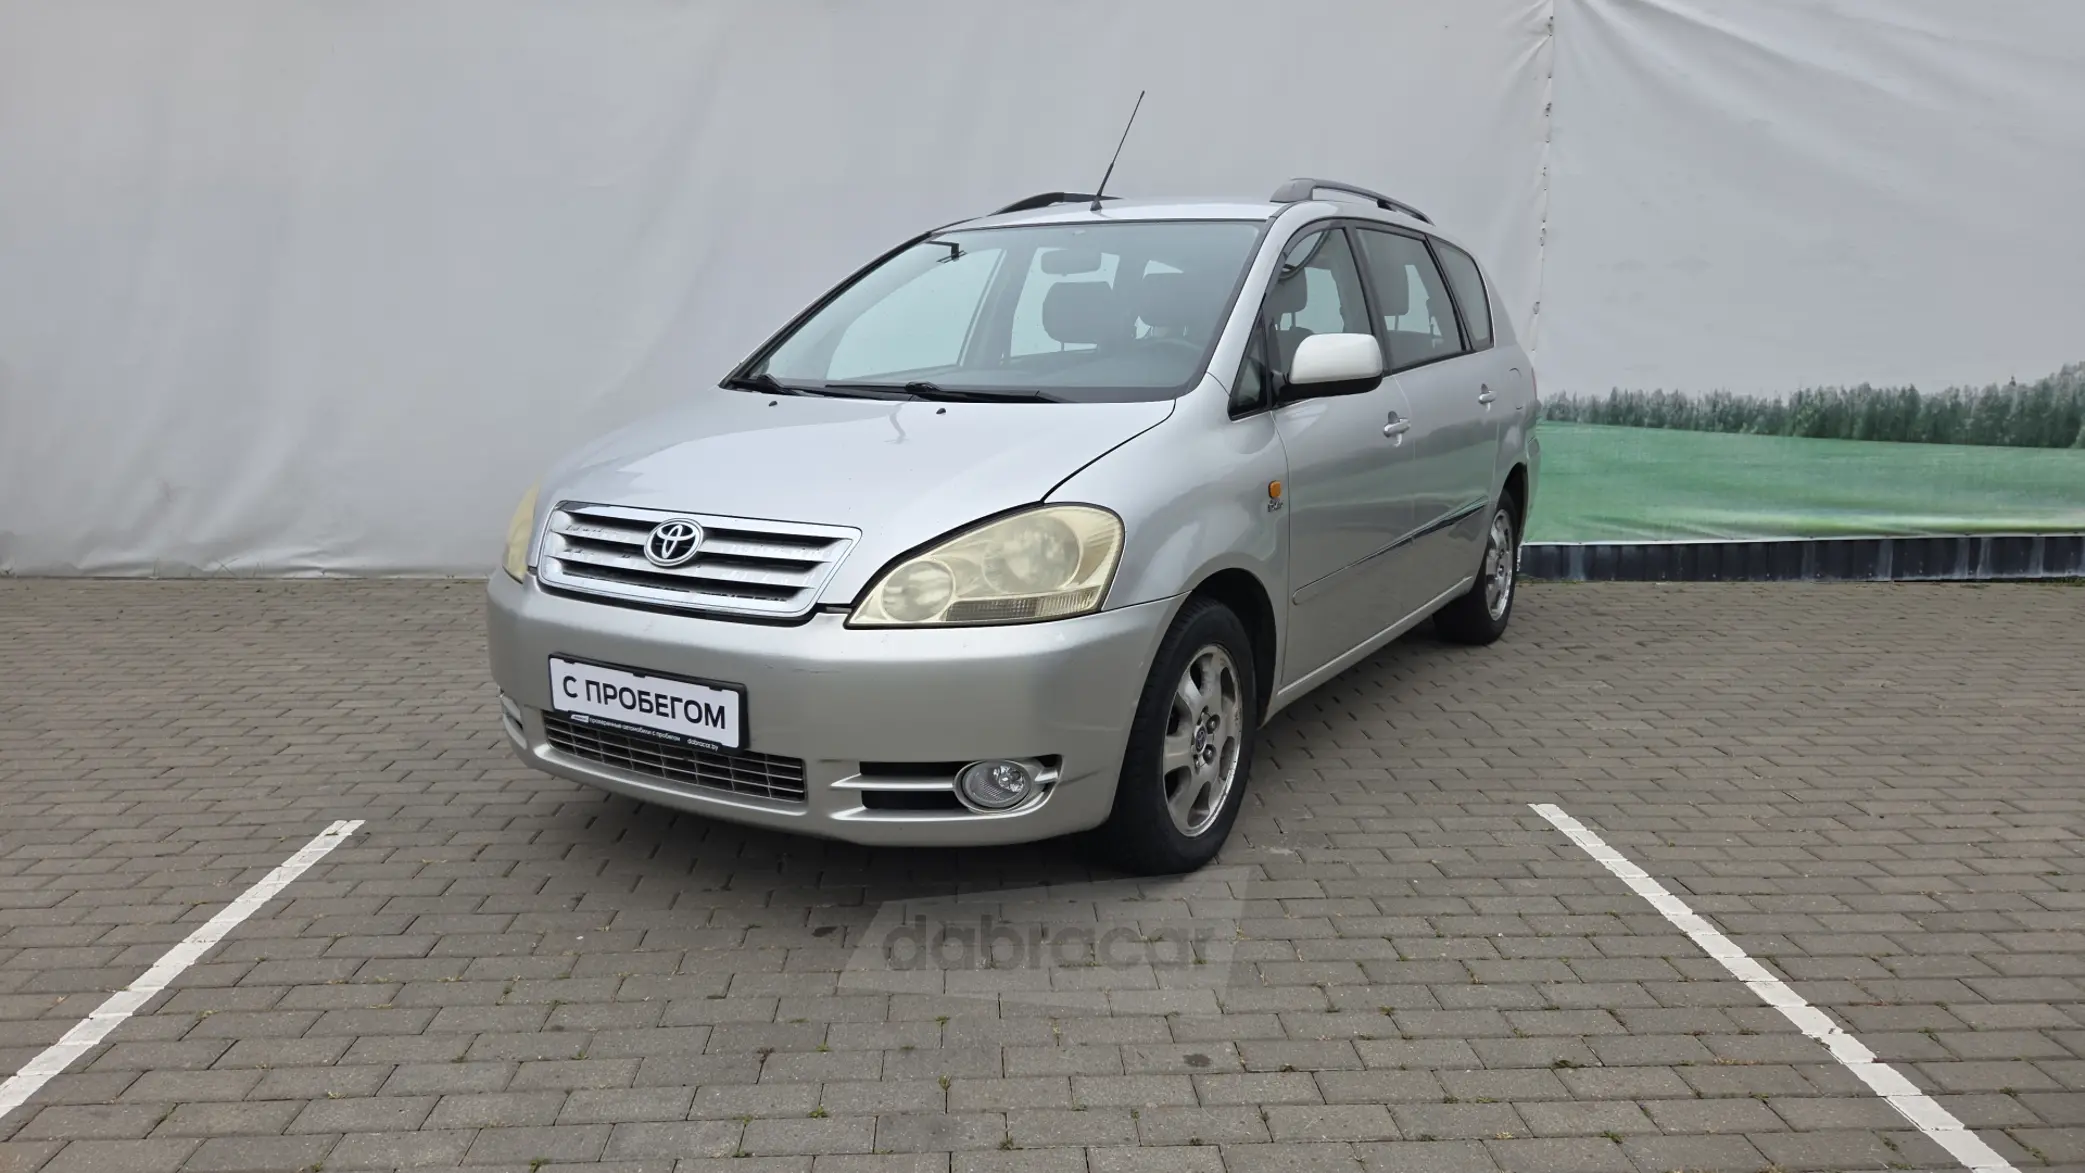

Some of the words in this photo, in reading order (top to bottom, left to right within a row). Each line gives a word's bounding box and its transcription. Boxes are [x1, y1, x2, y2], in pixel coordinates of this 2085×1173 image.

[563, 675, 578, 698] С
[585, 679, 726, 730] ПРОБЕГОМ
[656, 731, 681, 742] пробегом
